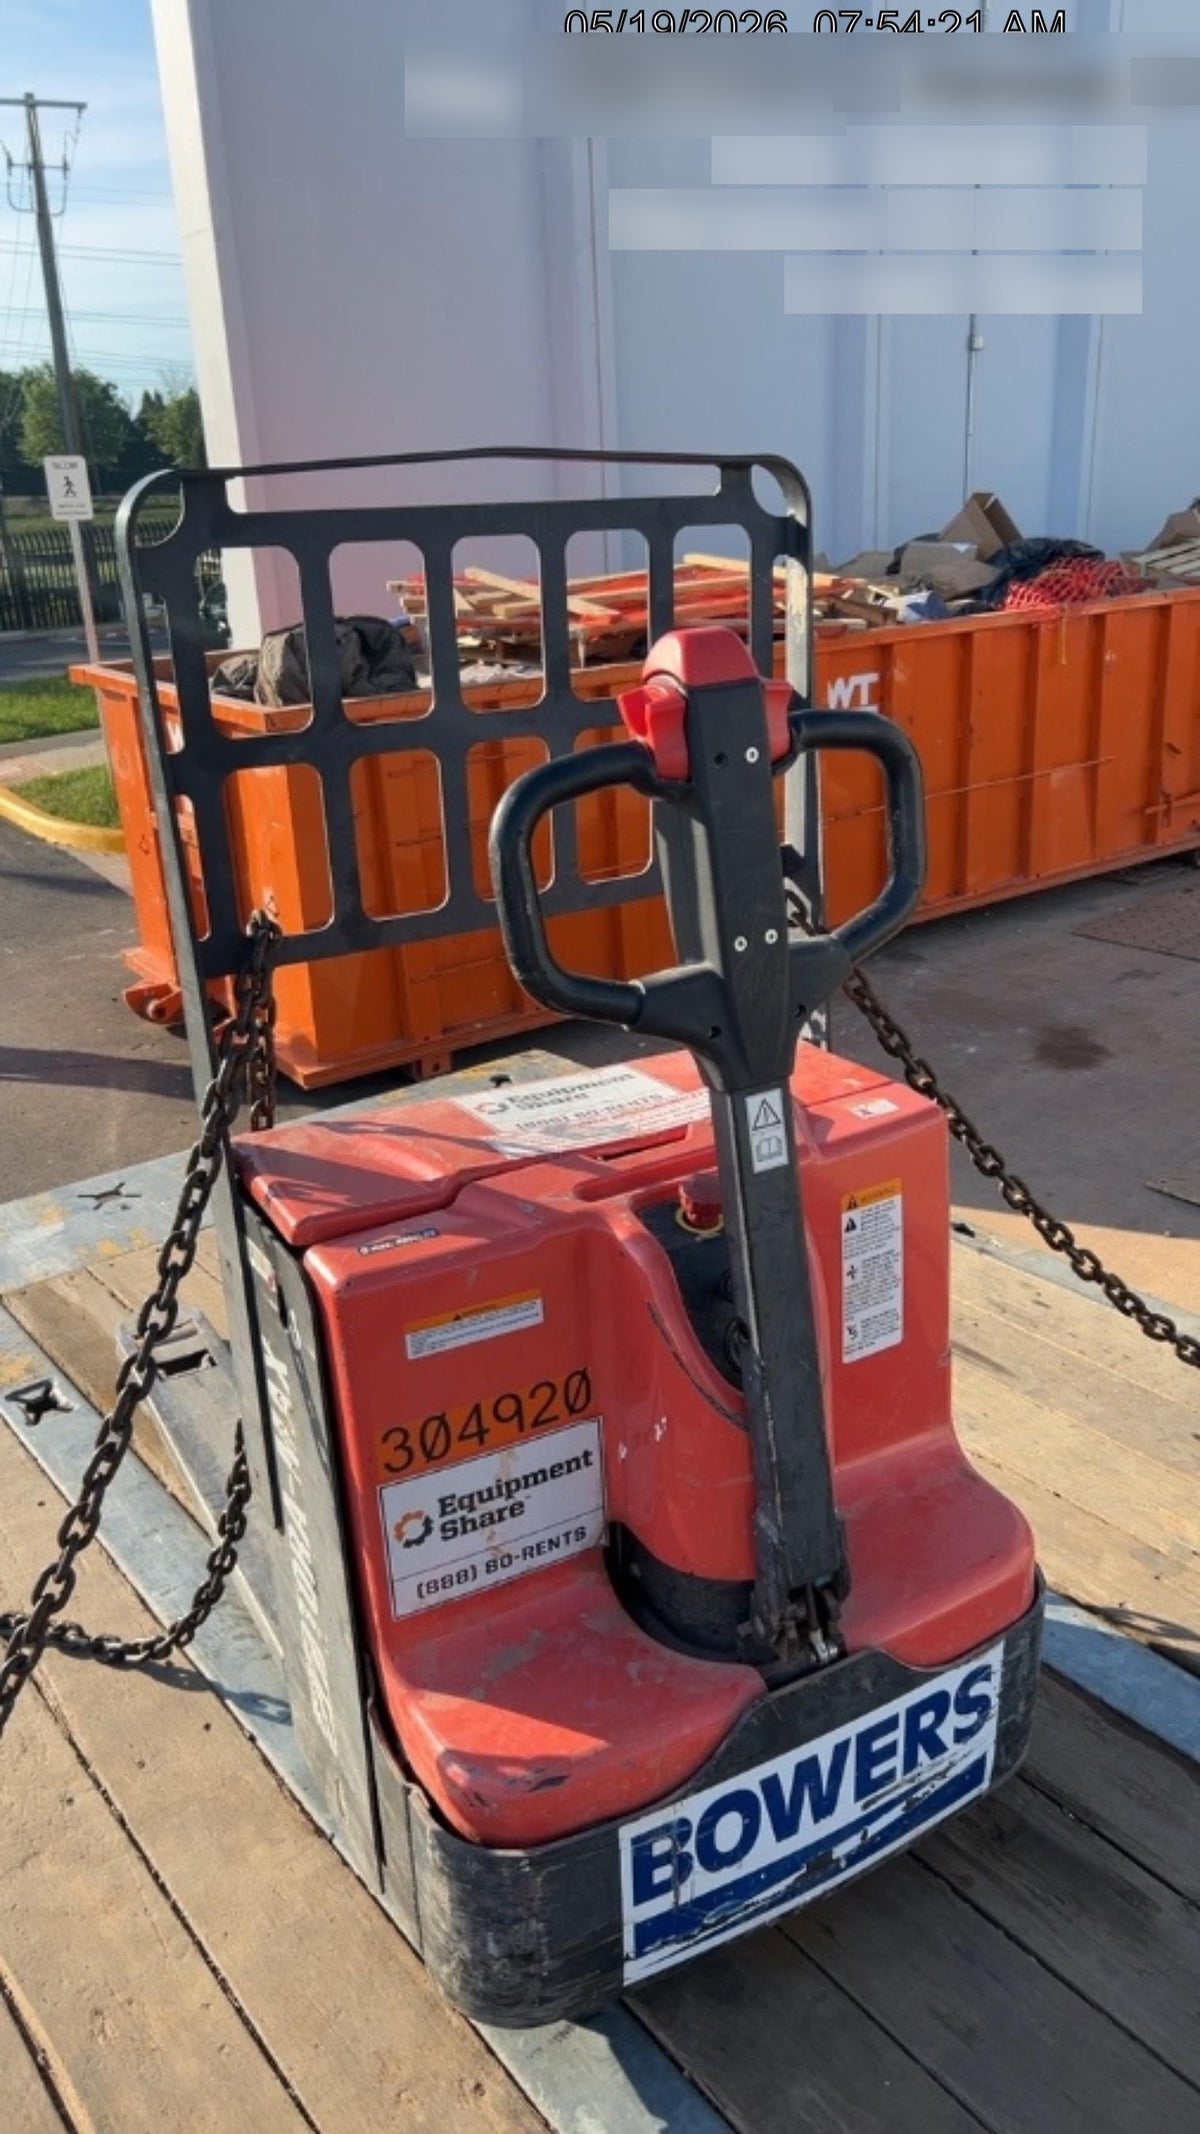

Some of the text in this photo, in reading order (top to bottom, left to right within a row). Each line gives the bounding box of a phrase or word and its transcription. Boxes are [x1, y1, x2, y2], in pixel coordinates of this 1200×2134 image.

[381, 1367, 592, 1473] 304920
[437, 1449, 594, 1519] Equipment
[440, 1500, 526, 1542] Share
[416, 1526, 587, 1599] (888) 80-RENTS
[631, 1663, 993, 1907] BOWERS
